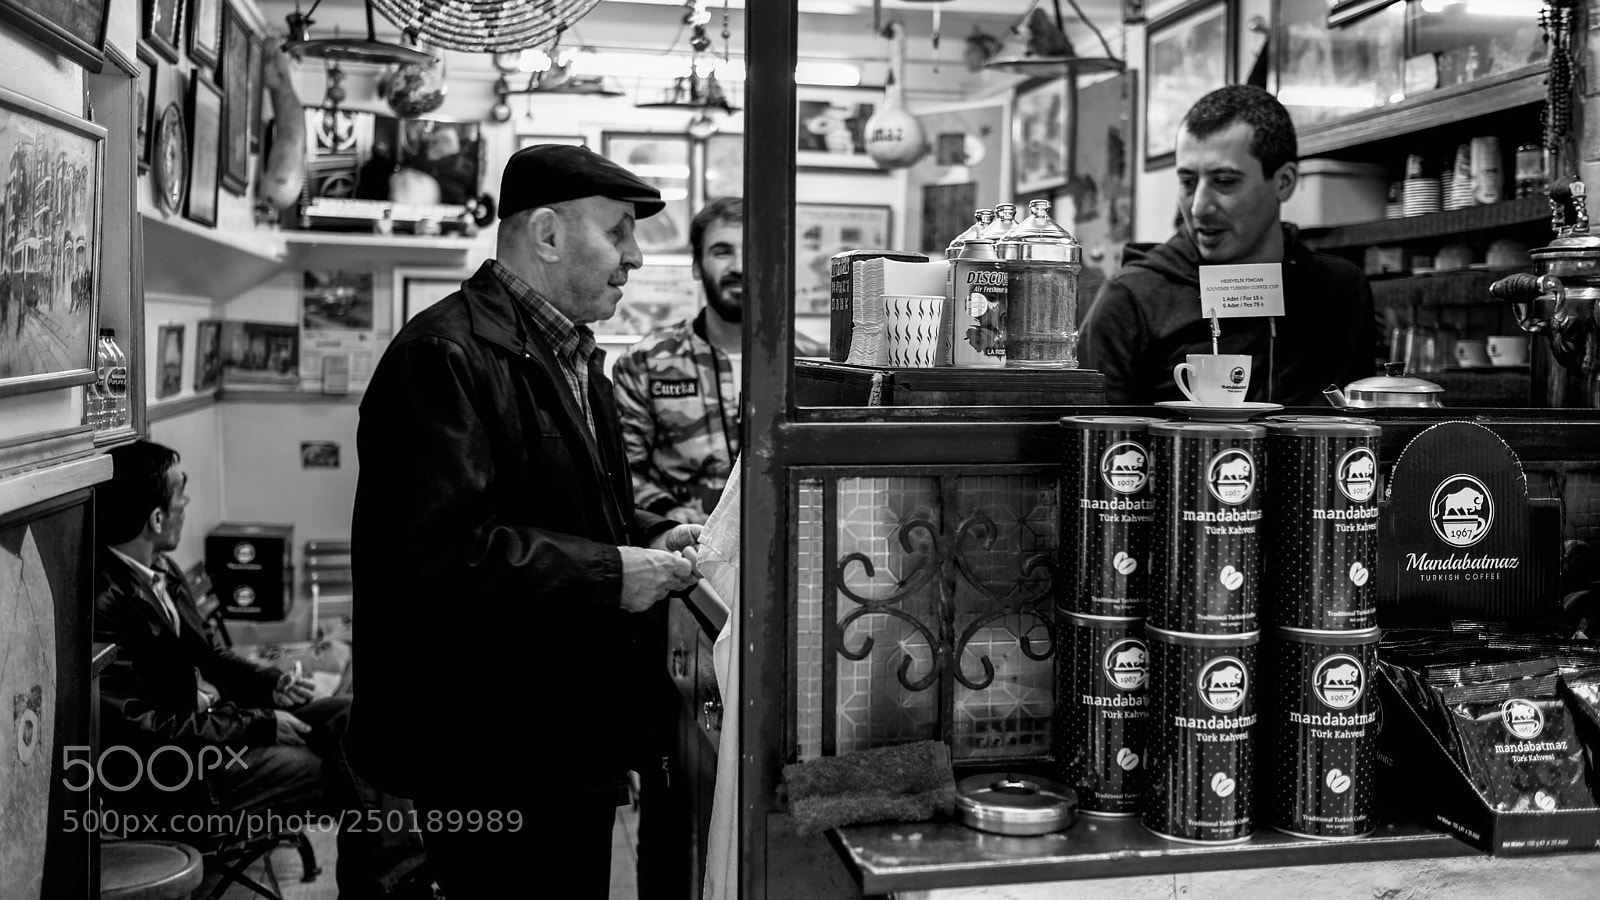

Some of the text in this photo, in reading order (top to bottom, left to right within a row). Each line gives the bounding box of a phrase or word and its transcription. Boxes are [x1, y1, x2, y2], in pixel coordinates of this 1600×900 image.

[1121, 513, 1152, 522] Kahv
[1451, 528, 1473, 540] 1967
[1406, 552, 1520, 571] Mandabatmaz
[1420, 573, 1501, 582] TURKISH COFFEE
[1102, 710, 1122, 719] Türk
[1196, 733, 1218, 742] Türk
[1311, 728, 1365, 739] Türk Kahvesi
[1495, 741, 1568, 754] mandabatmaz
